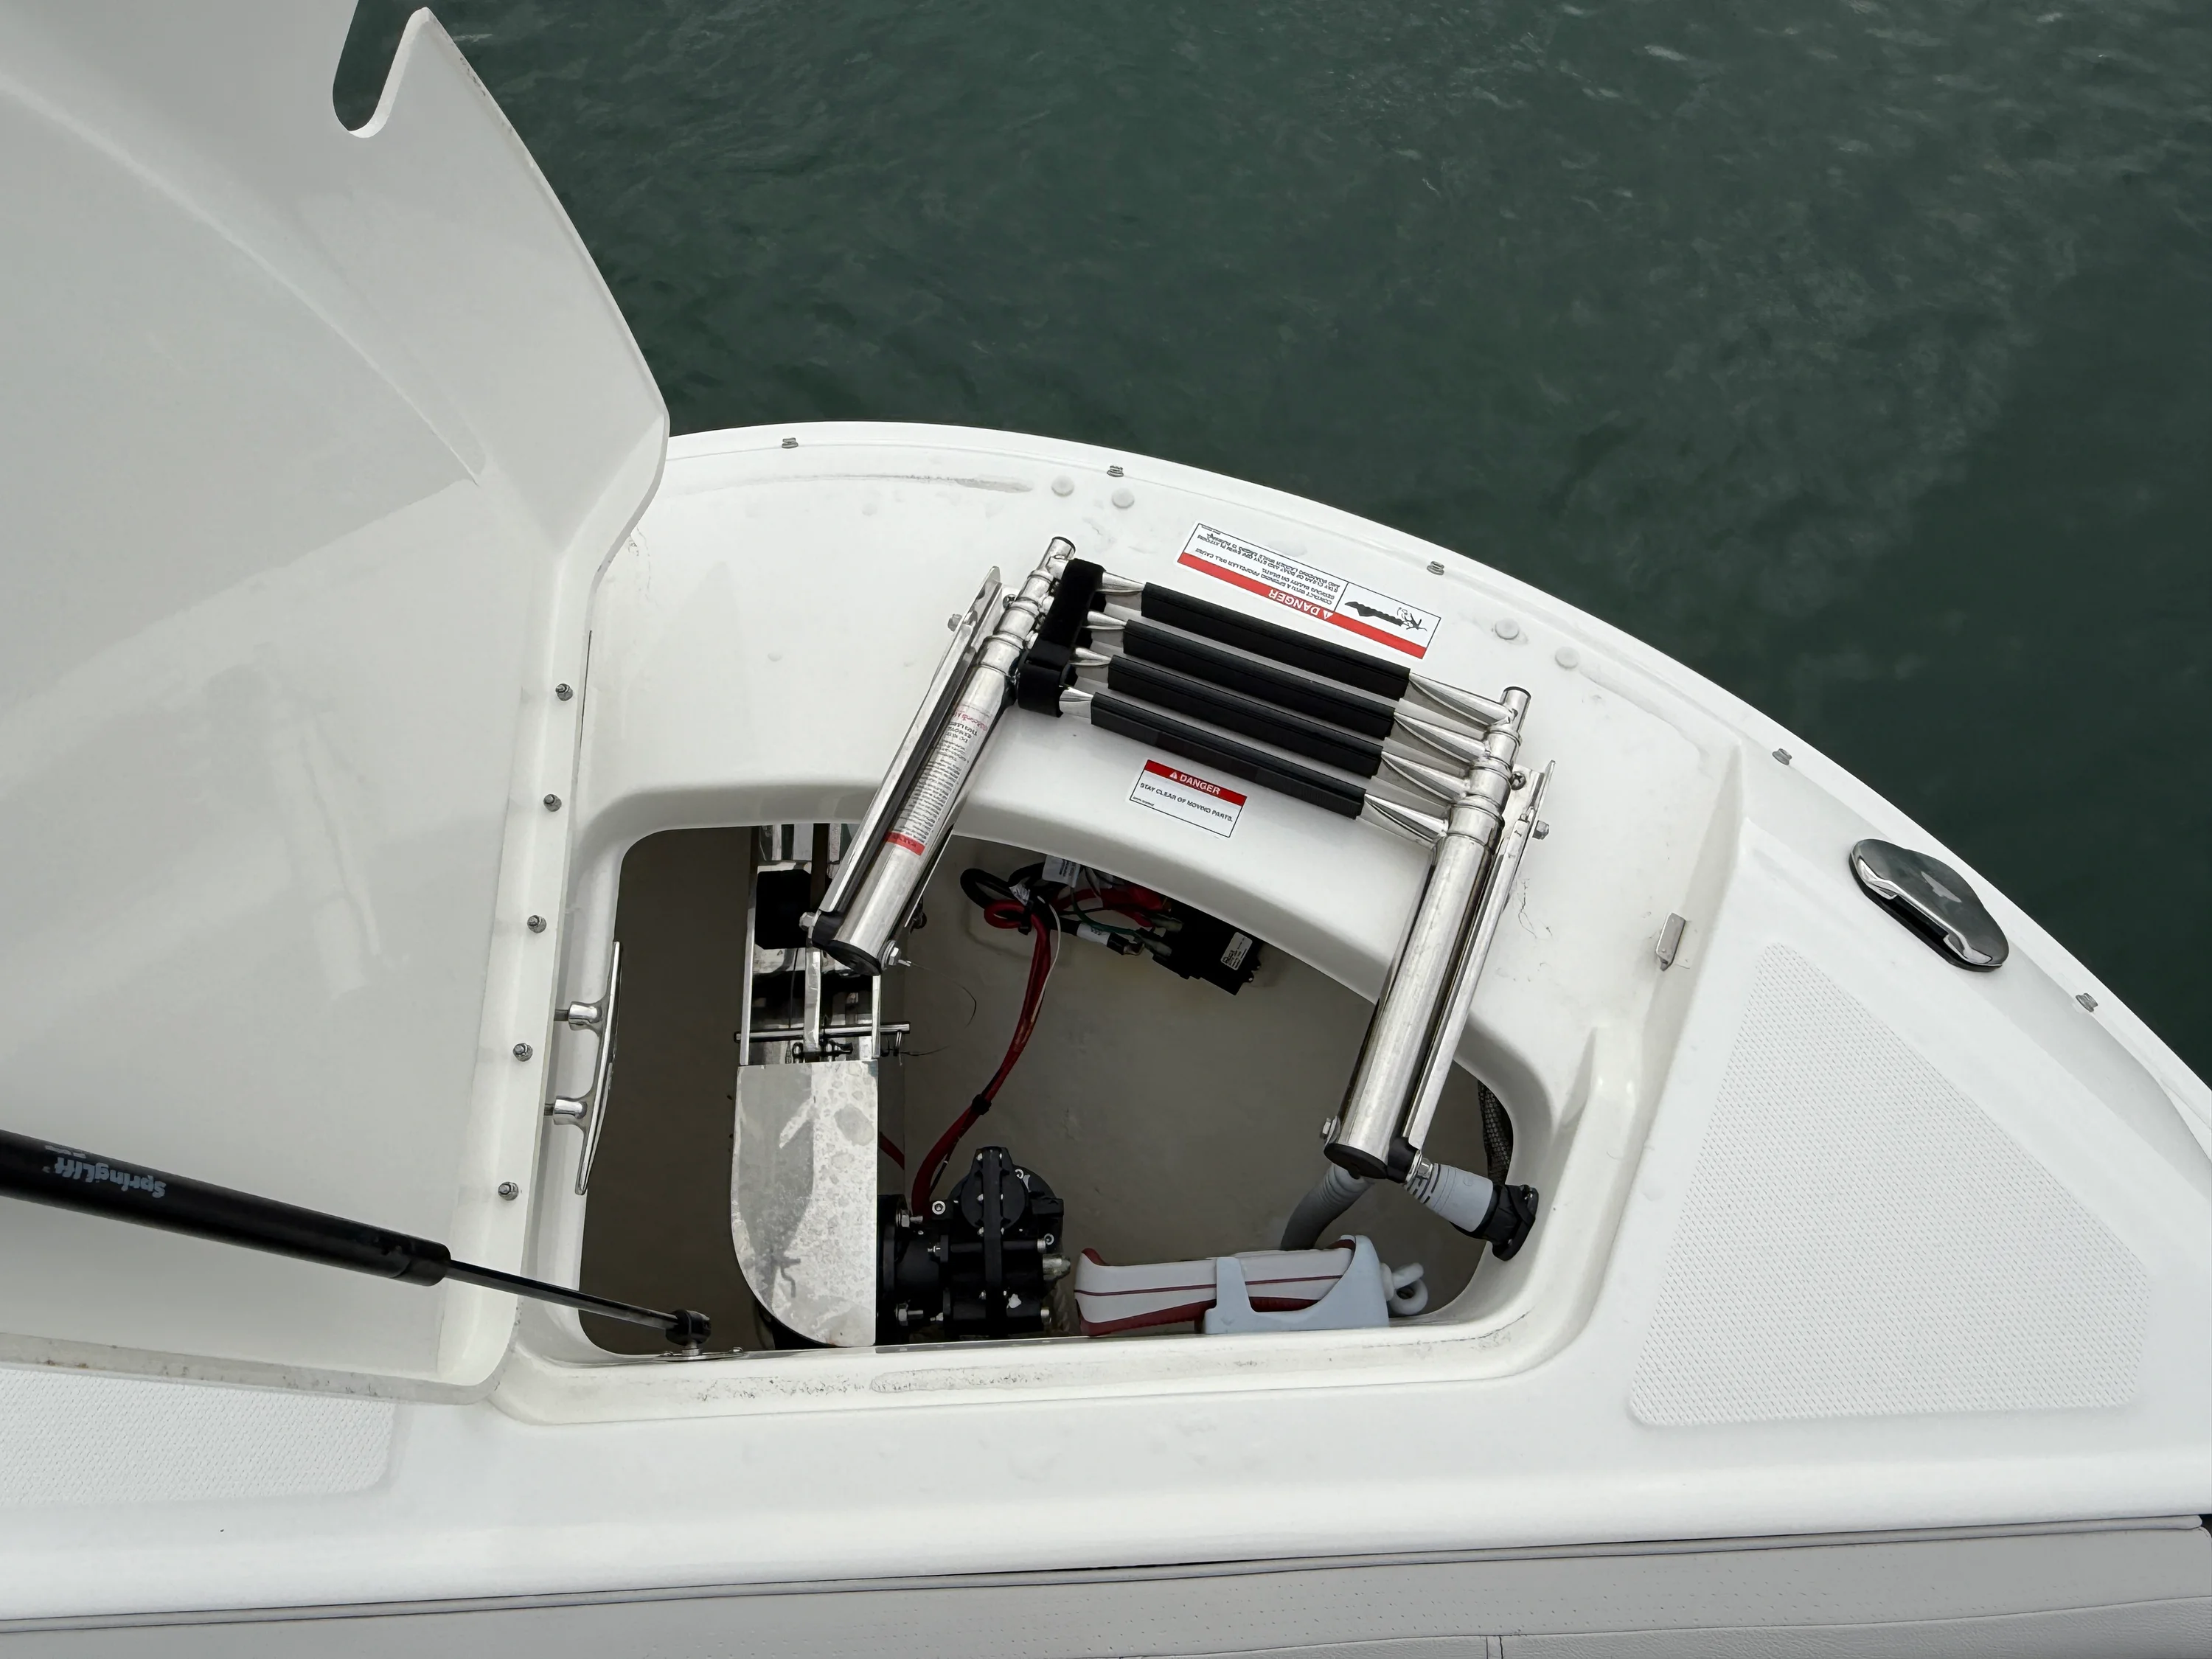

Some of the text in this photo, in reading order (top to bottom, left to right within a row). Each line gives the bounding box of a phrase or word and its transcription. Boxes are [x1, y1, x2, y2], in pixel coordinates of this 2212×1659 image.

[1267, 588, 1321, 616] DANGER
[1179, 774, 1221, 796] DANGER
[55, 1157, 166, 1198] SpringLift
